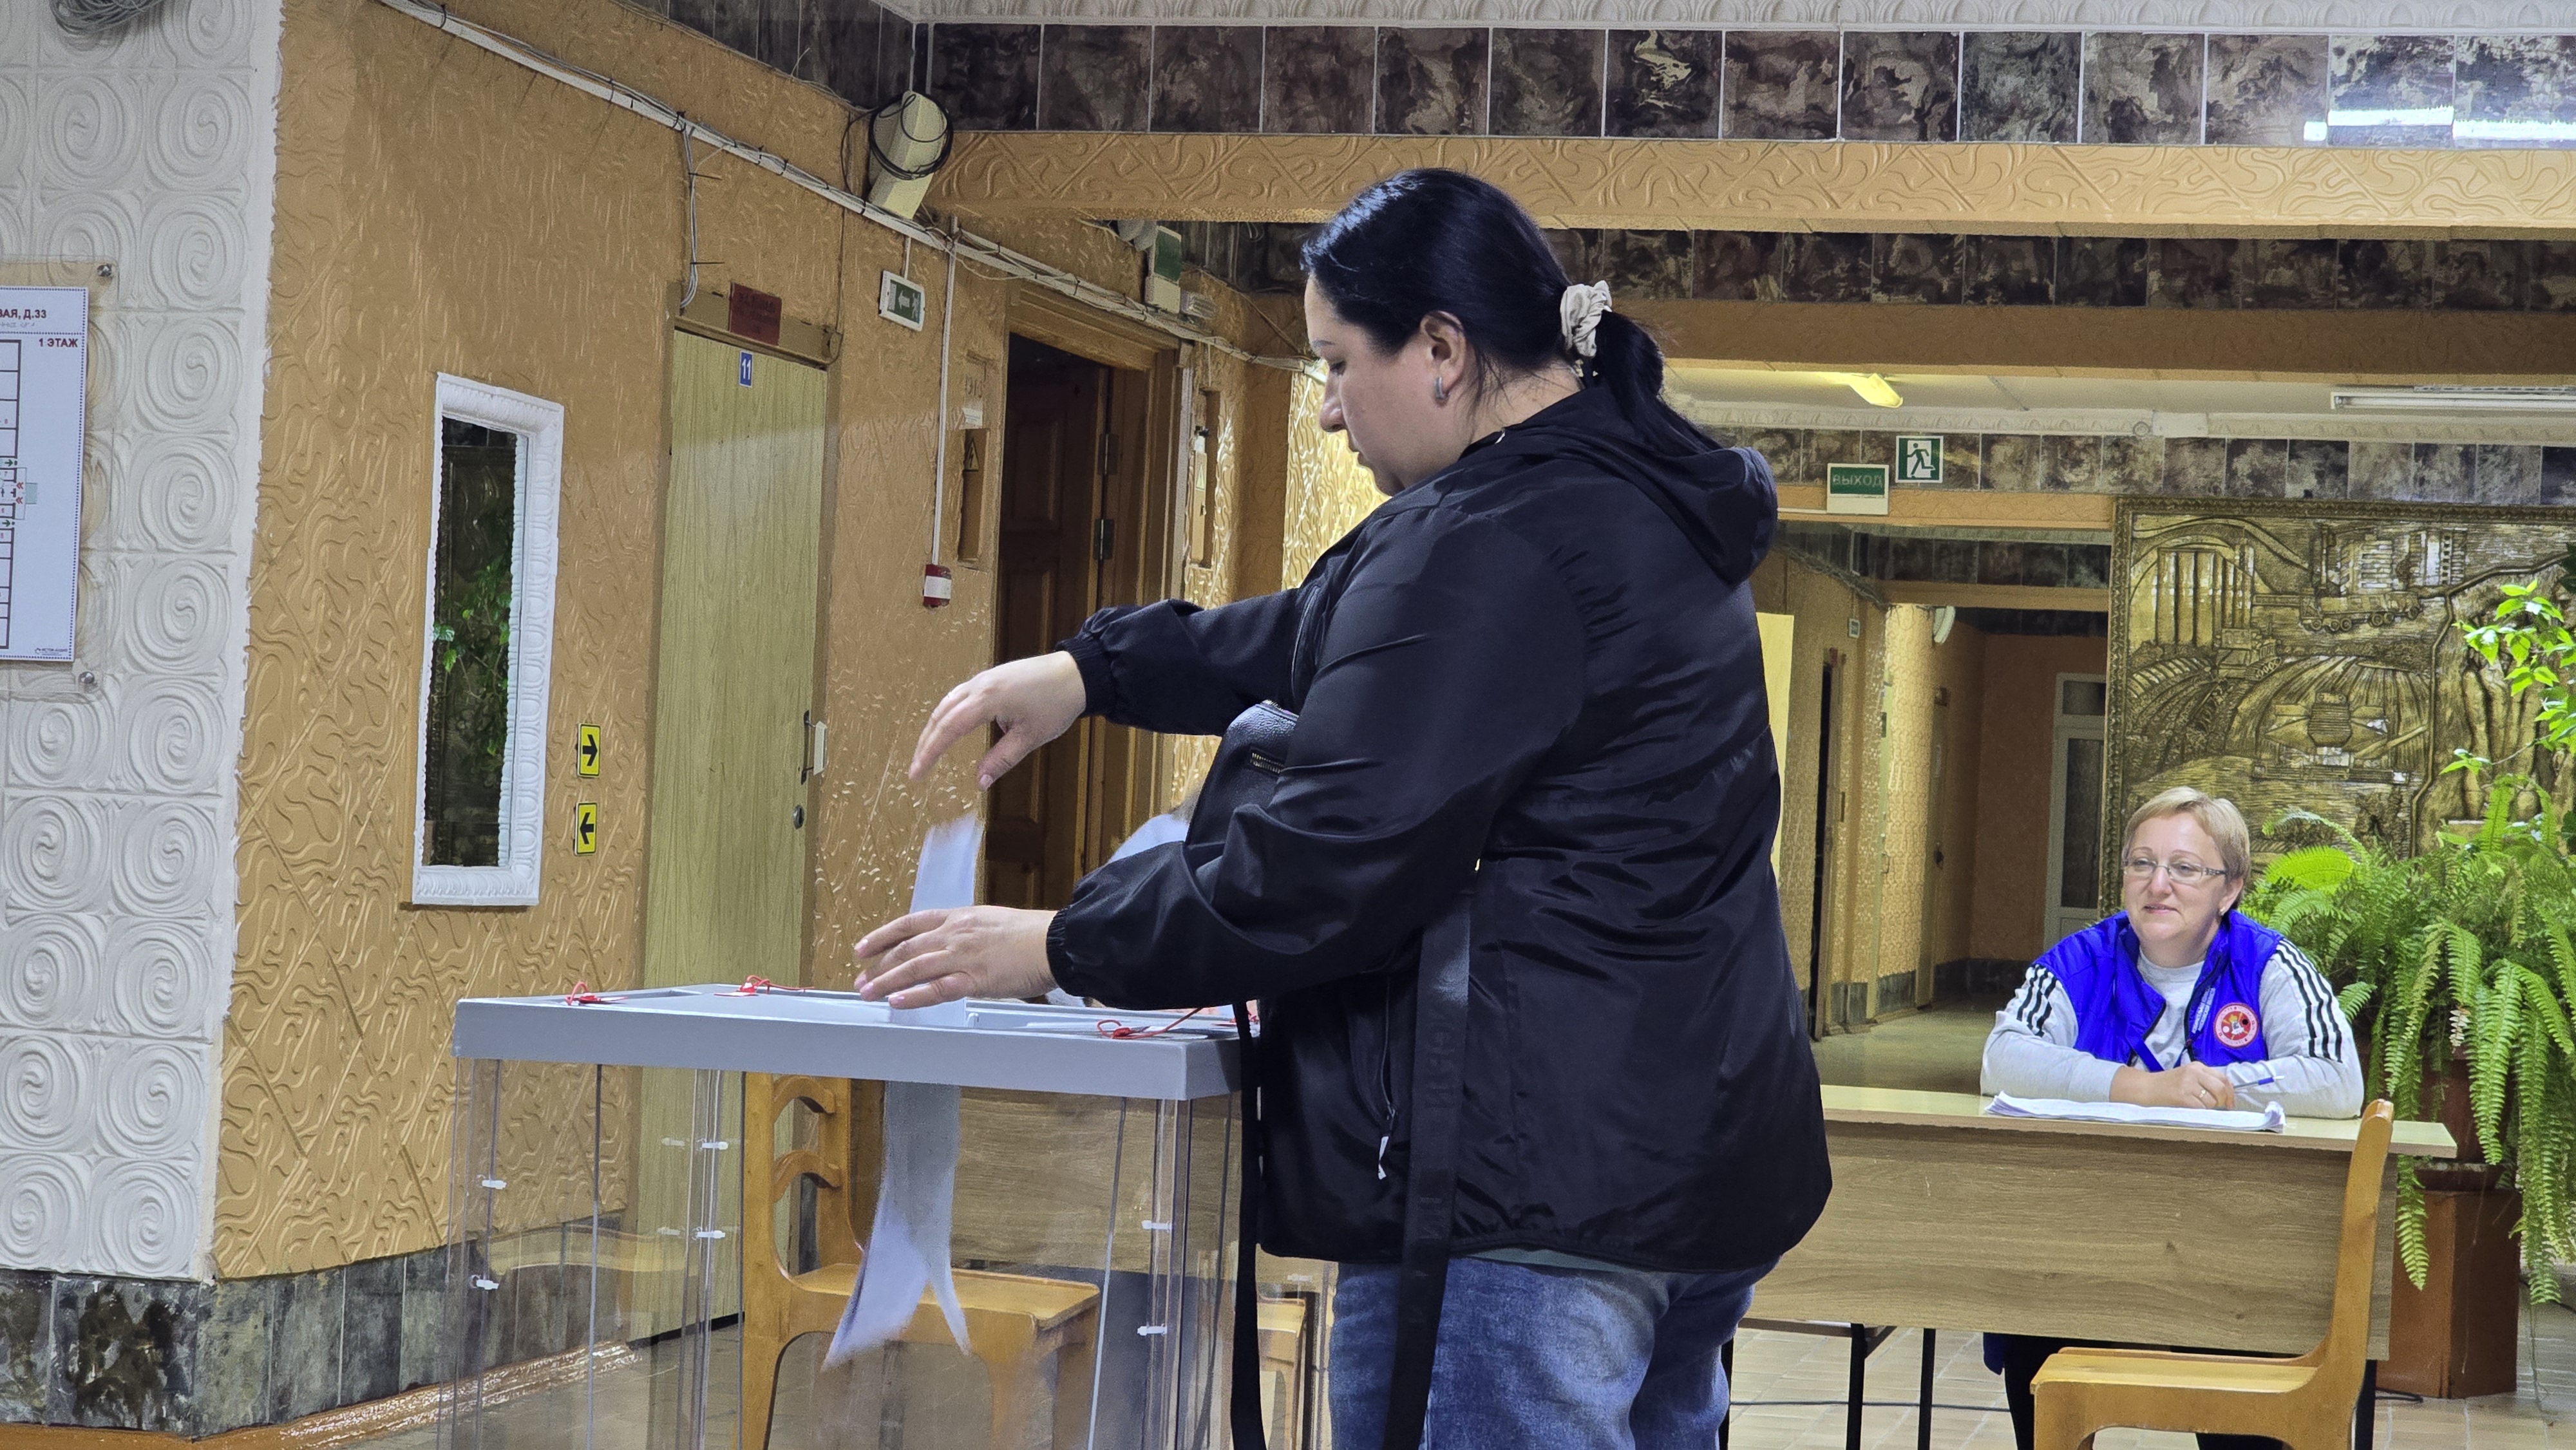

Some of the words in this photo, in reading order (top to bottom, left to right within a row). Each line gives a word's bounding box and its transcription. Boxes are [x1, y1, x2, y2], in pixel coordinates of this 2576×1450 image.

[23, 309, 46, 320] Д.33
[39, 338, 43, 347] 1
[47, 338, 78, 347] ЭТАЖ
[742, 359, 752, 380] 11
[1833, 475, 1882, 487] ВЫХОД
